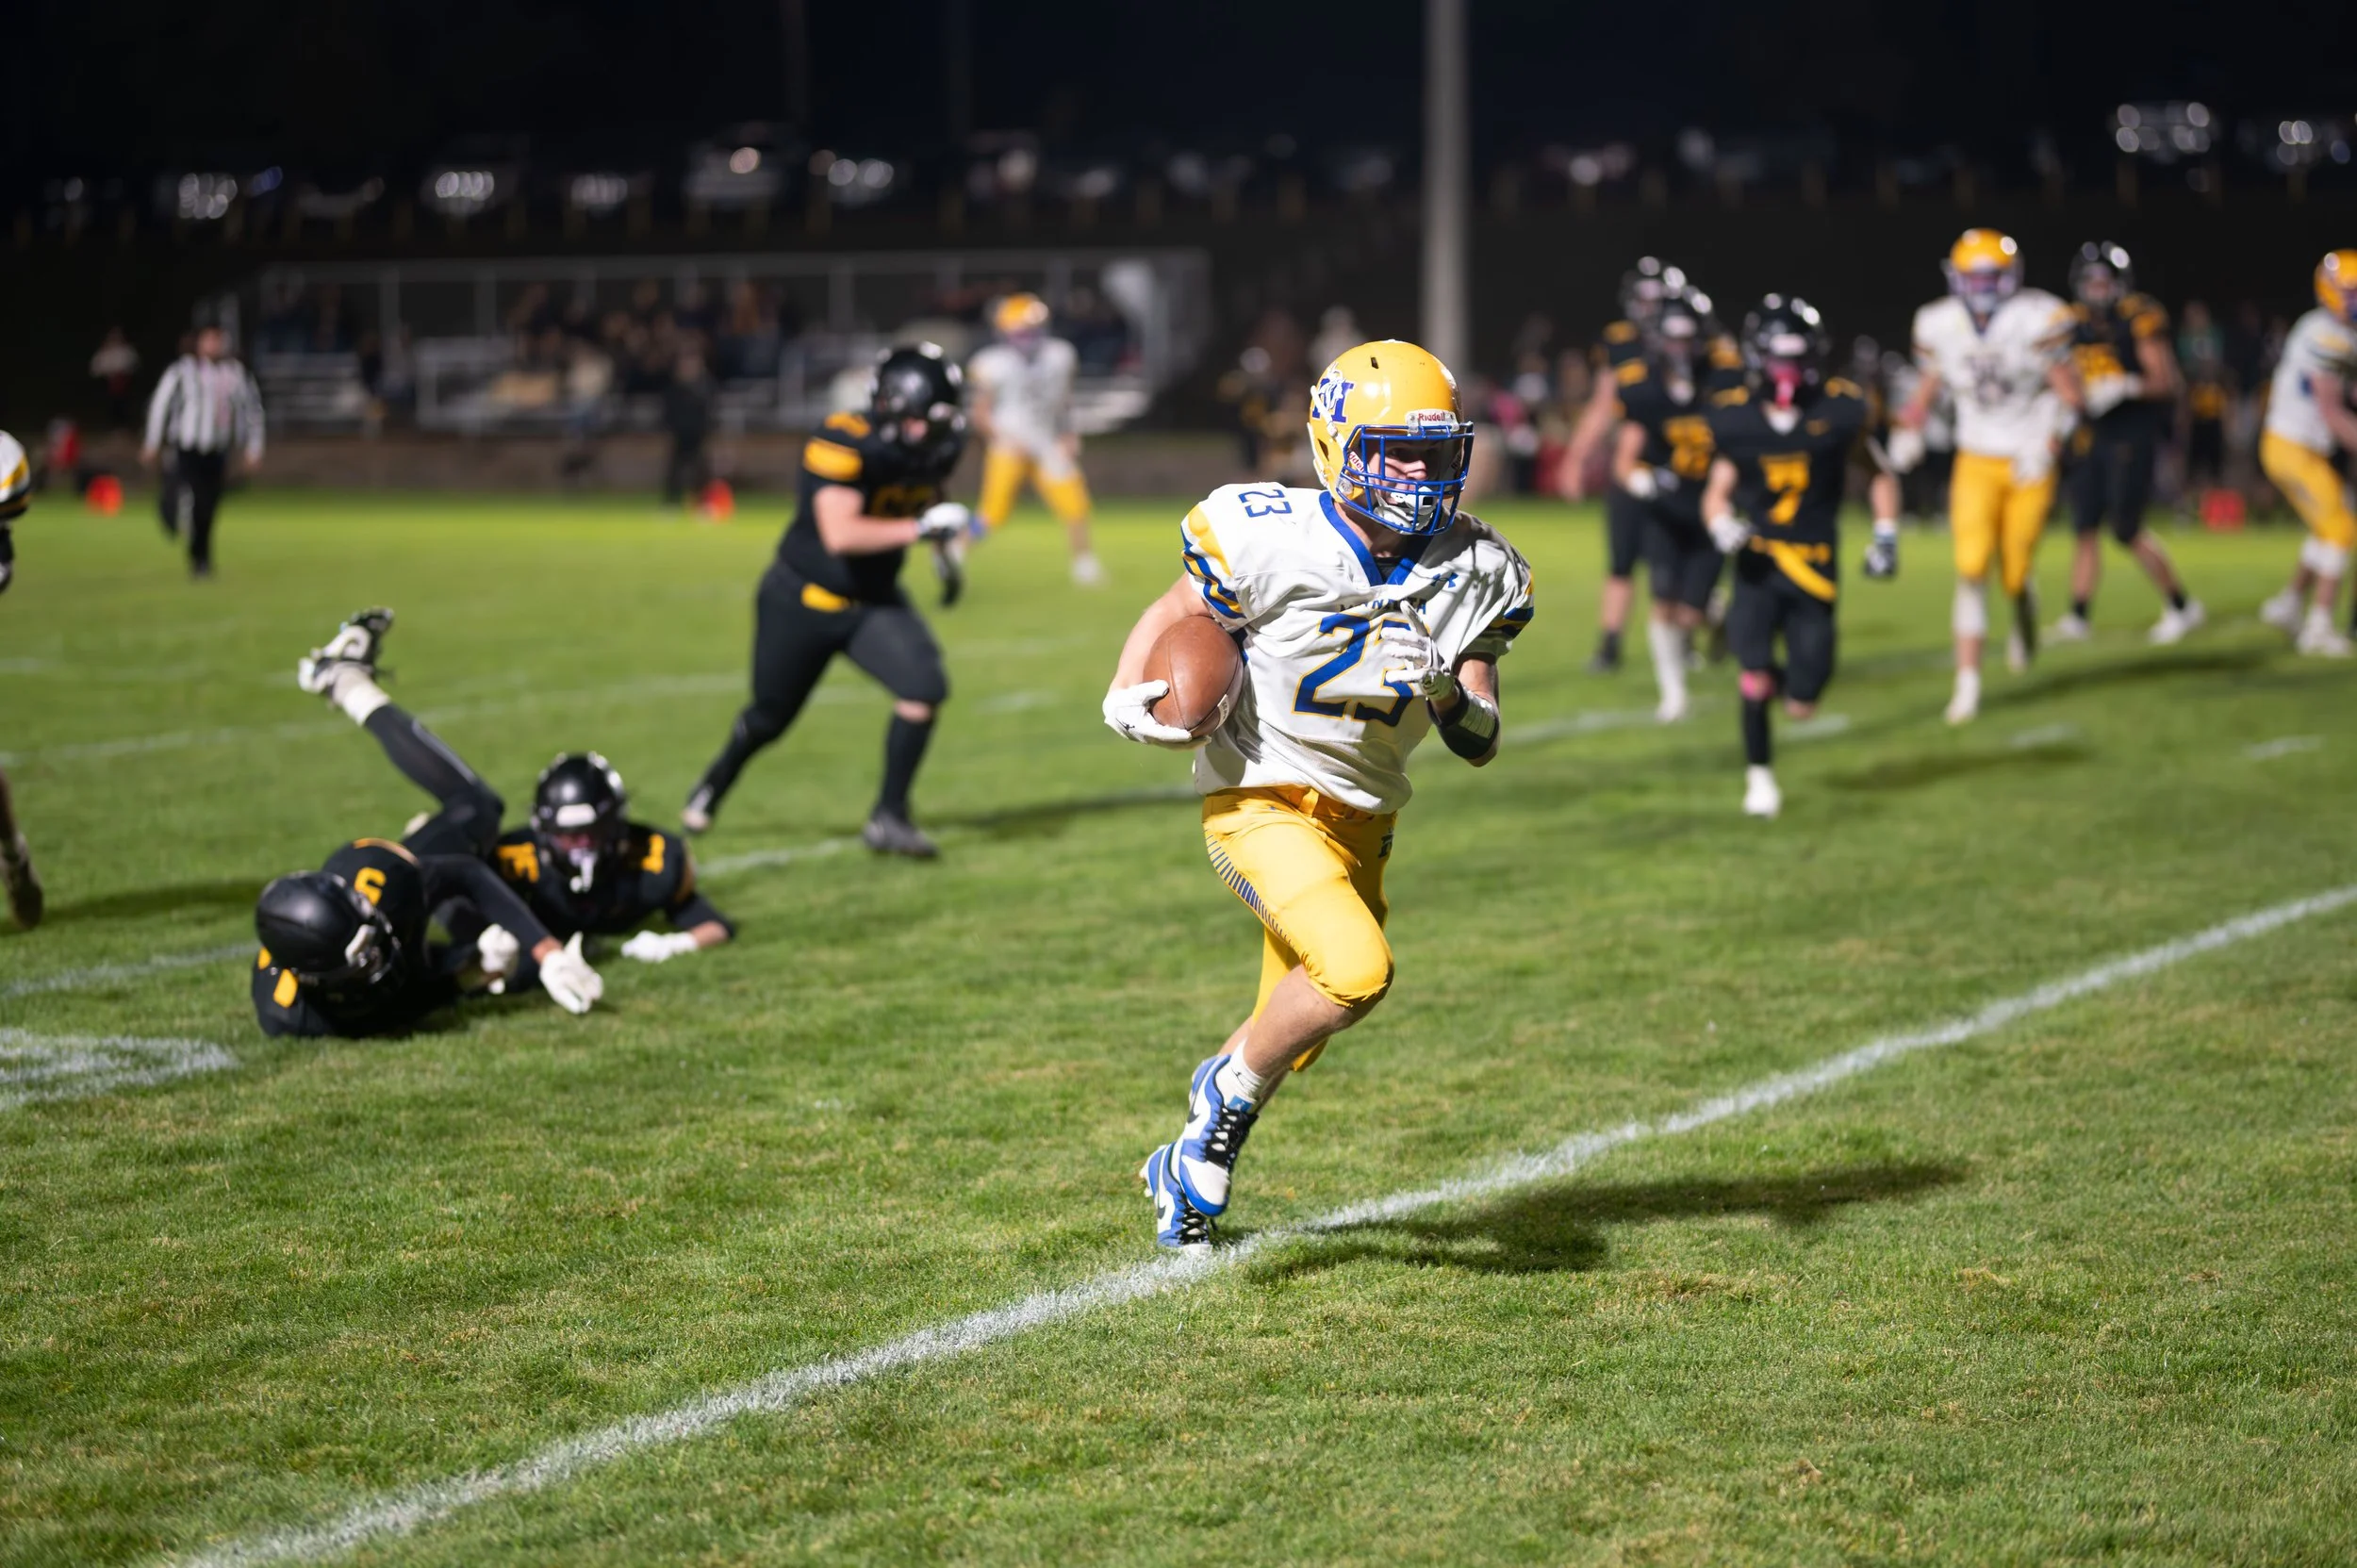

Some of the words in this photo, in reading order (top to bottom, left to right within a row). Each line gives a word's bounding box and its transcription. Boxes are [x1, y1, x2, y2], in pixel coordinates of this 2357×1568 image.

[1417, 411, 1446, 421] Riddell
[1759, 450, 1810, 525] 7
[1238, 488, 1293, 518] 23
